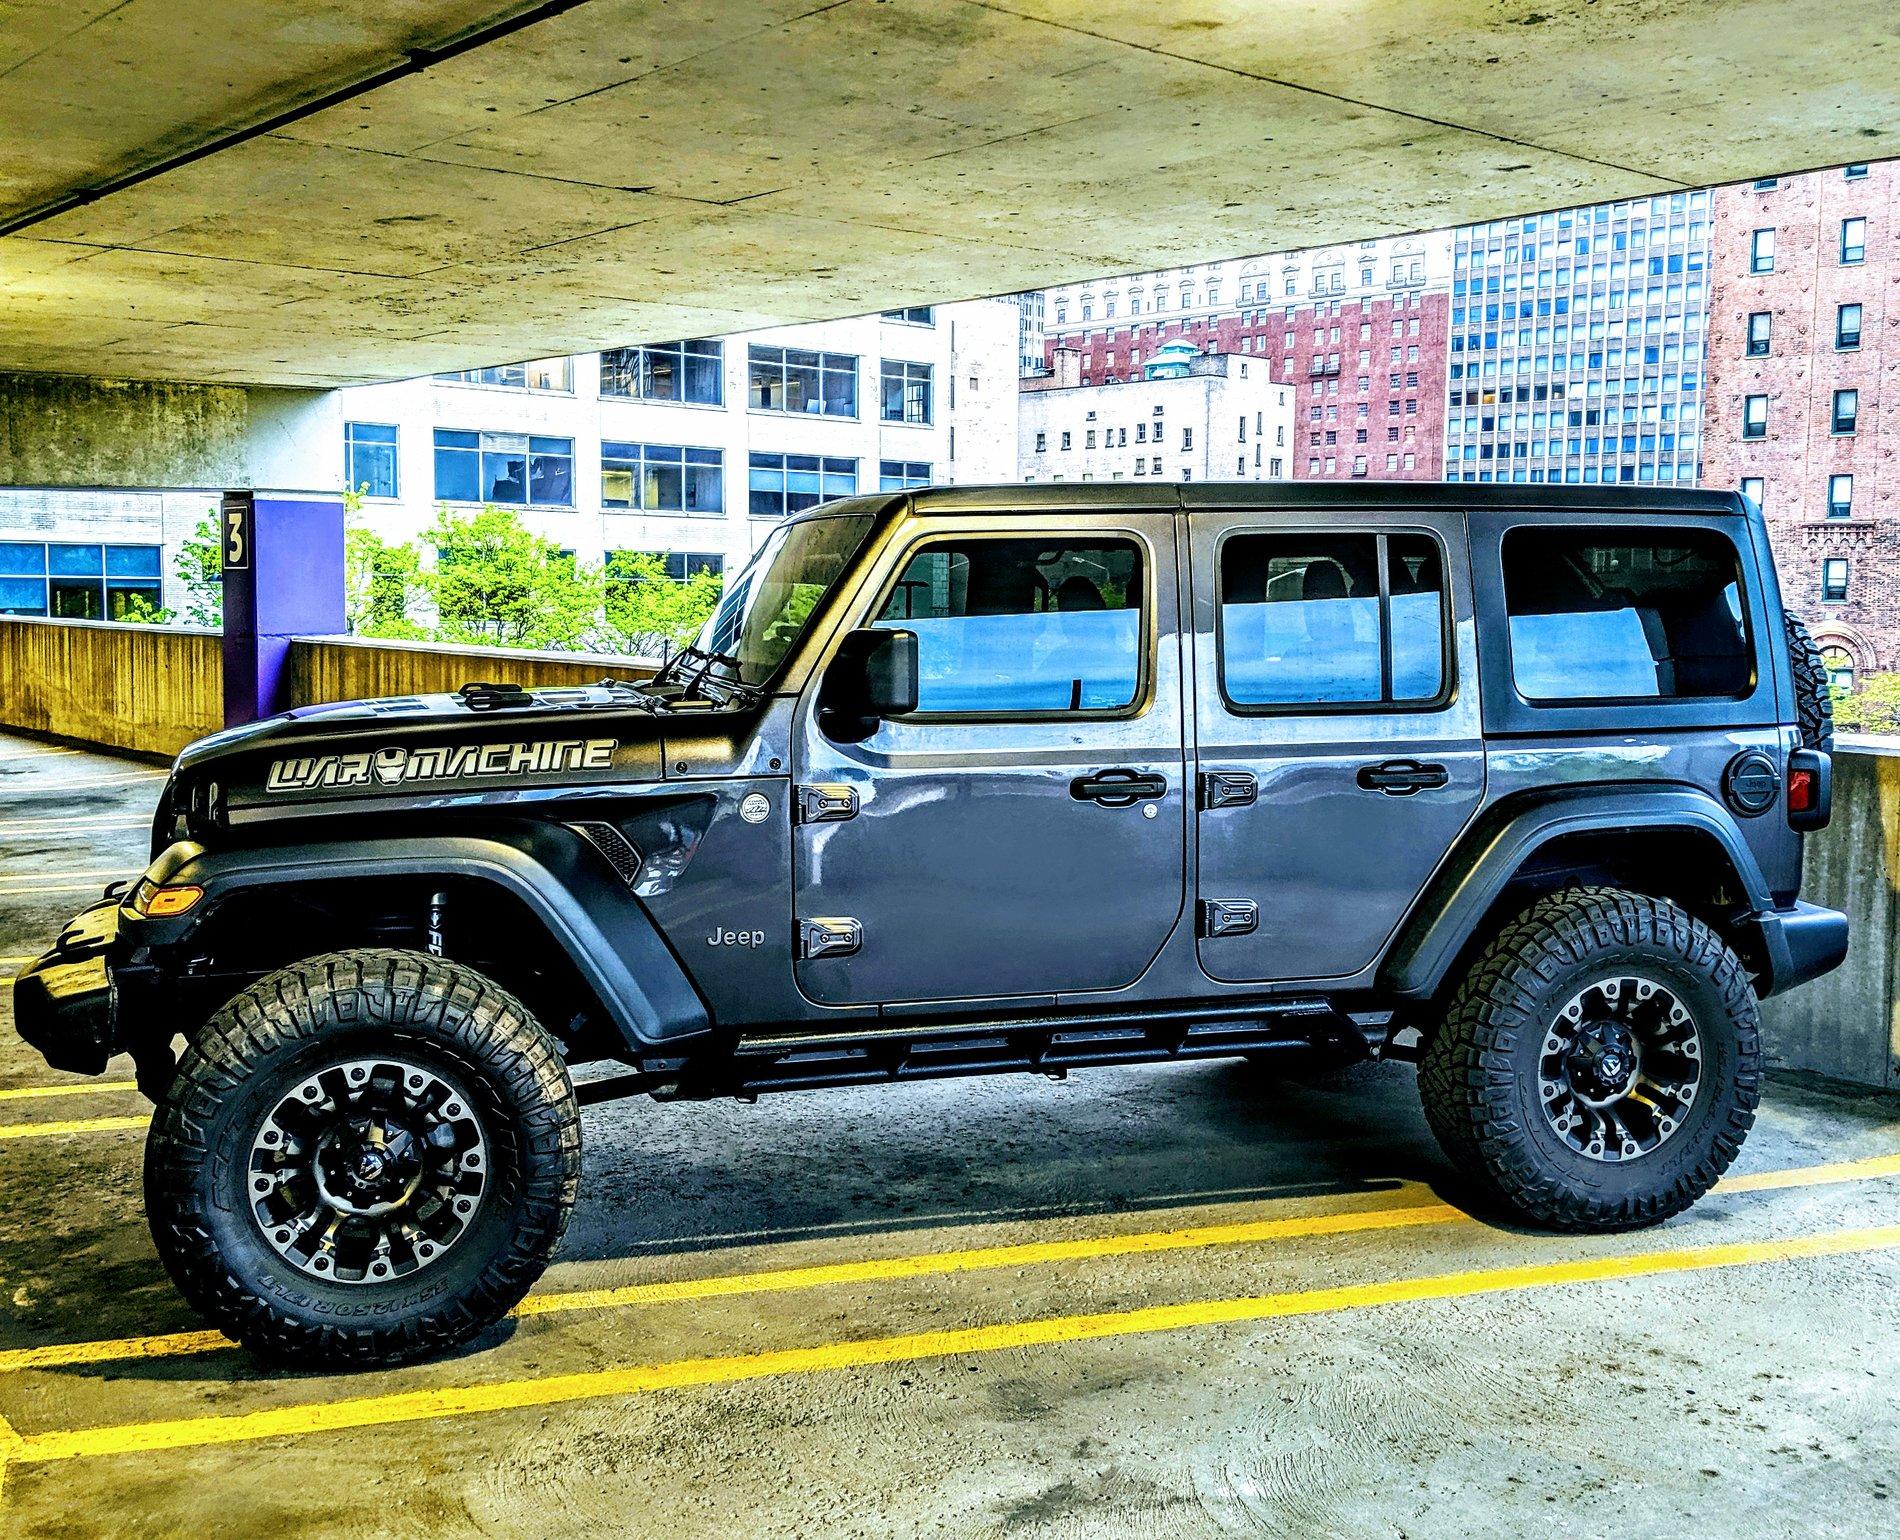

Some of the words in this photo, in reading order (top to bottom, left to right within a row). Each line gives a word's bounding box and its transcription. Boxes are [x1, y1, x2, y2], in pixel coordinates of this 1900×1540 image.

[228, 513, 243, 563] 3
[266, 753, 373, 792] WAR
[404, 739, 618, 783] MACHINE
[707, 926, 765, 949] Jeep
